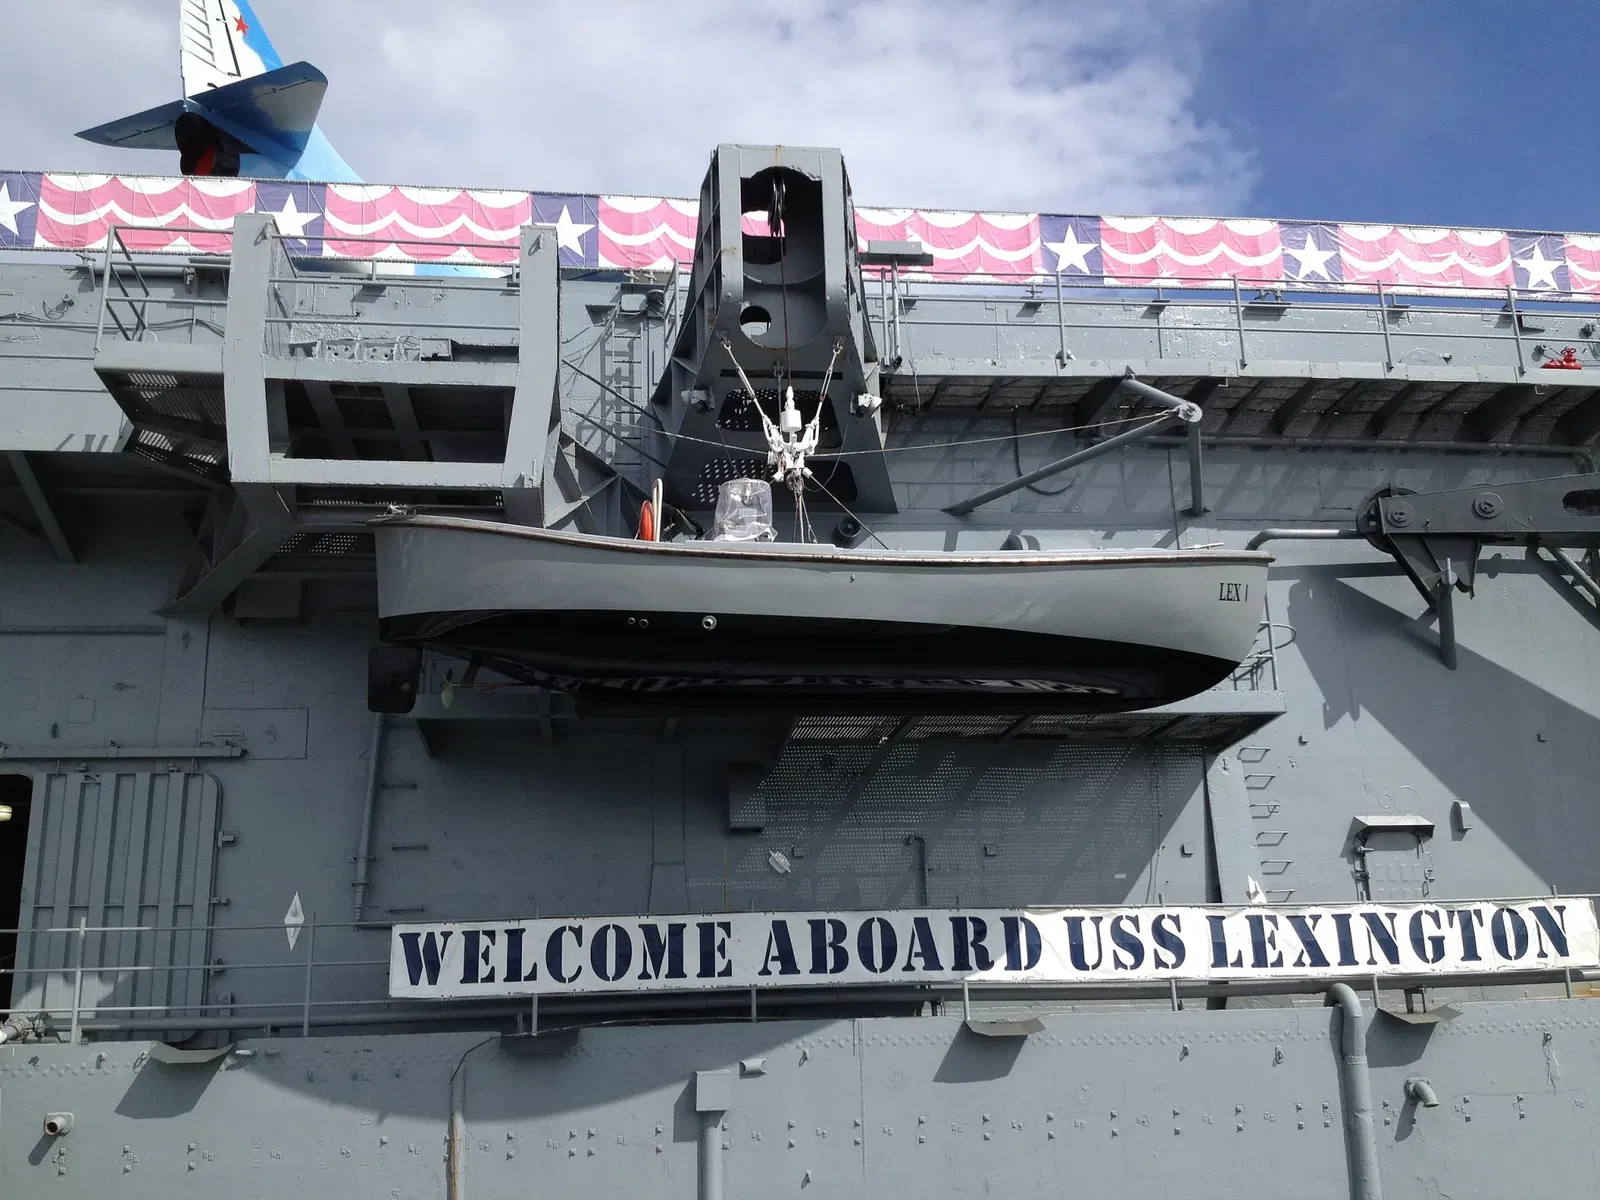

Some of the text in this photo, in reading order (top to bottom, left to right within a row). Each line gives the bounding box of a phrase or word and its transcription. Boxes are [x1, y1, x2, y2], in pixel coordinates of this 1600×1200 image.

[1219, 582, 1241, 602] LEX
[399, 905, 1570, 986] WELCOME ABOARD USS LEXINGTON
